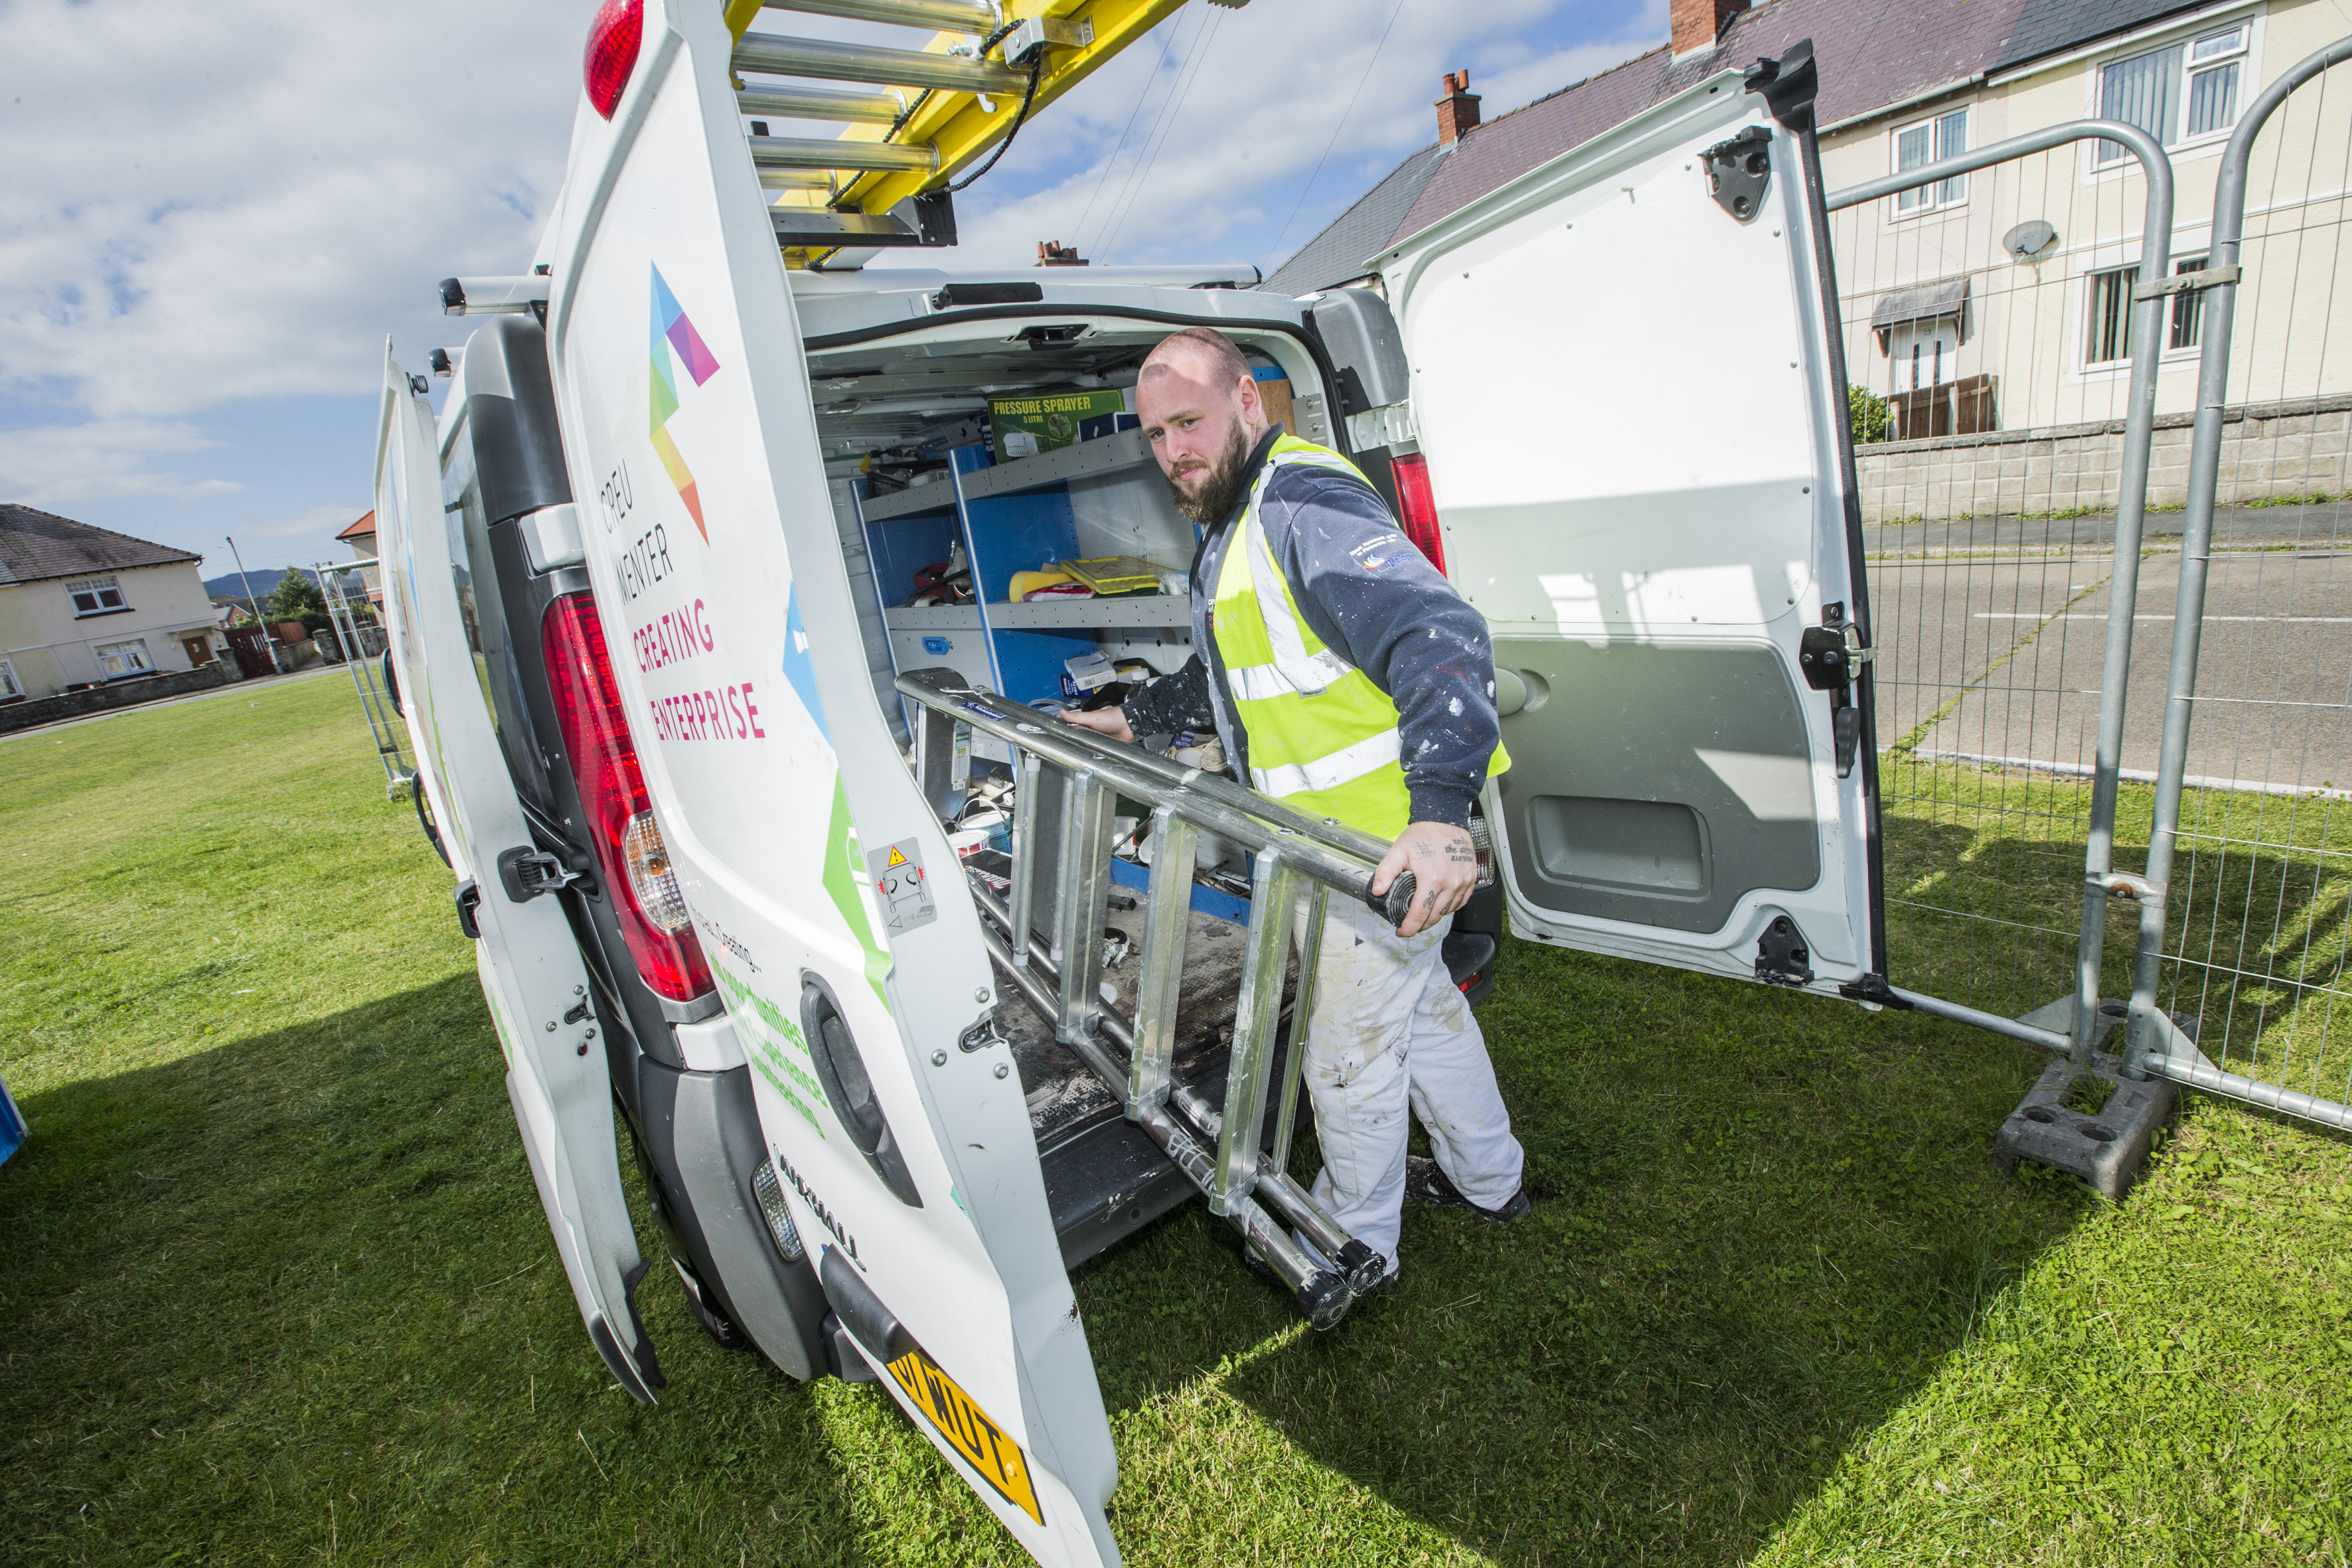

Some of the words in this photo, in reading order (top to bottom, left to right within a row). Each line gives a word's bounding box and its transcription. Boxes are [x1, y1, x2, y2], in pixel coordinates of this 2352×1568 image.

[993, 400, 1042, 415] PRESSURE
[1043, 396, 1091, 413] SPRAYER
[600, 459, 633, 534] CREU
[616, 523, 673, 605] MENTER
[1377, 553, 1414, 572] CREST
[633, 598, 714, 674] CREATING
[651, 682, 765, 741] ENTERPRISE
[722, 966, 809, 1056] opportunities
[773, 1142, 867, 1273] VAUXHALL
[919, 1360, 1010, 1486] WUT
